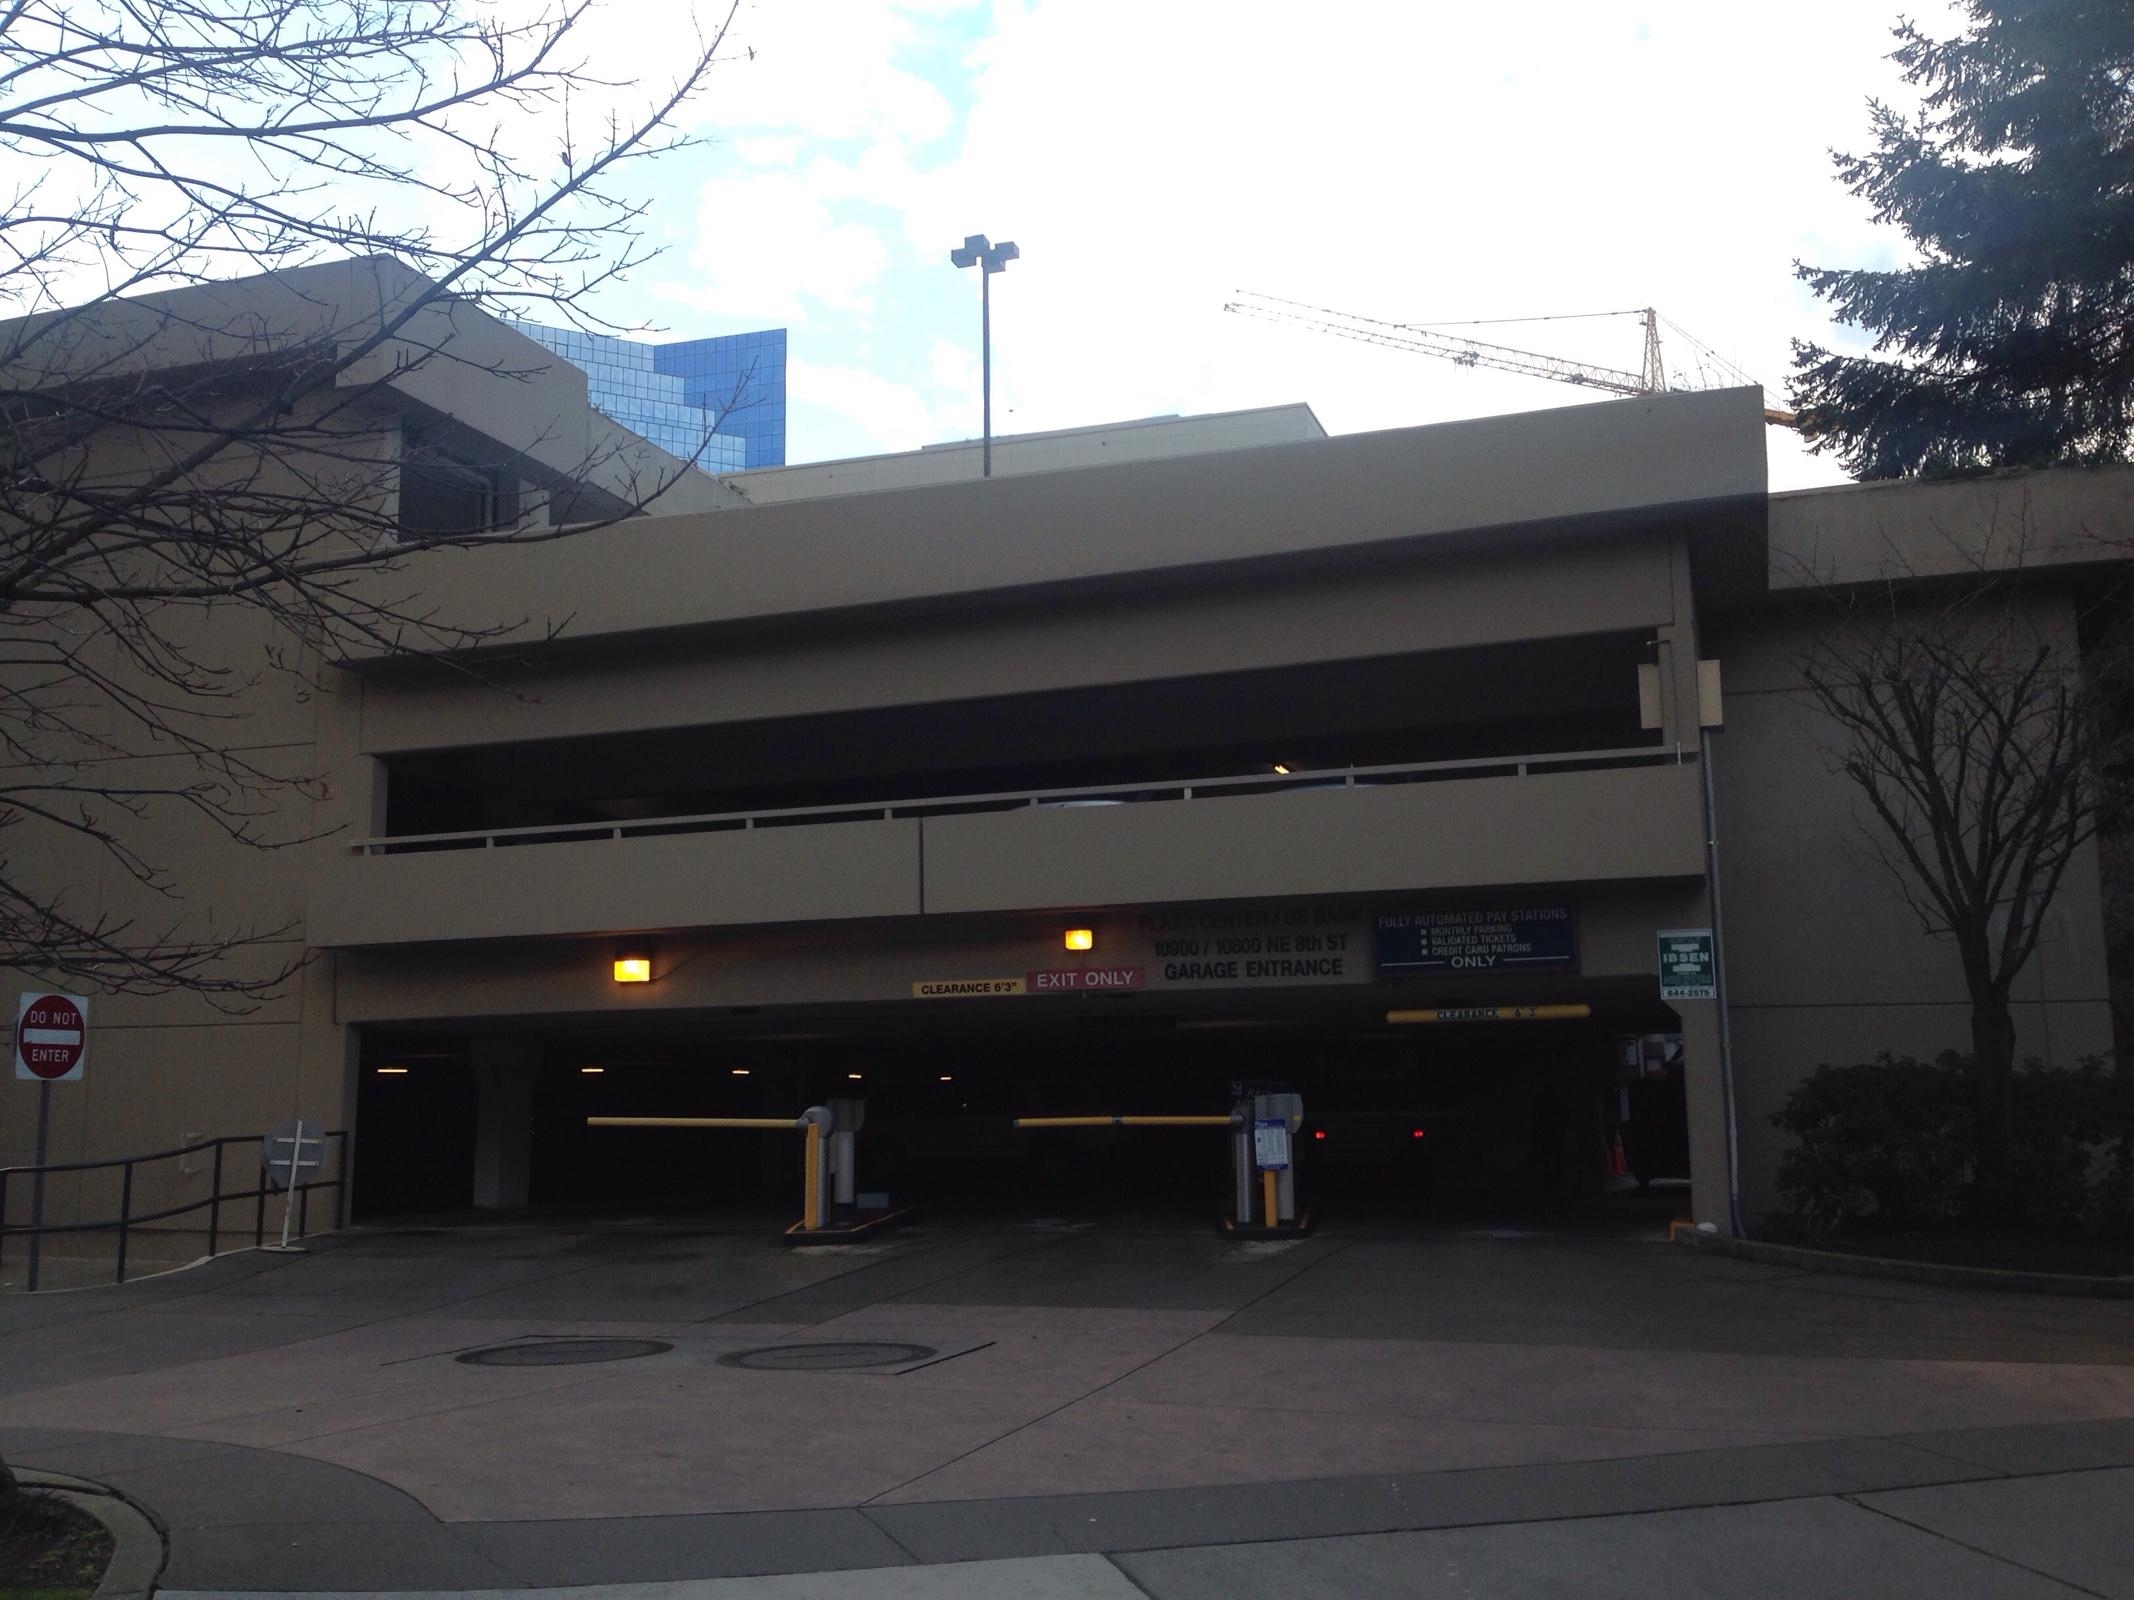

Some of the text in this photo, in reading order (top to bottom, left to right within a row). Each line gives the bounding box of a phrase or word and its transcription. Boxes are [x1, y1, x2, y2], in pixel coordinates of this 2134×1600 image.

[1378, 907, 1568, 928] FULLY AUTOMATED PAY STATIONS
[1430, 924, 1513, 936] MONTHLY PARKING
[1153, 940, 1199, 958] 10900
[1215, 937, 1261, 954] 10800
[1267, 936, 1290, 953] NE
[1295, 934, 1322, 952] 8th
[1326, 934, 1349, 950] ST
[1431, 934, 1517, 946] VALIDATED TICKETS
[1431, 943, 1532, 956] CREDIT CARD PATRONS
[1451, 955, 1496, 968] ONLY
[1663, 952, 1709, 963] IBSEN
[1165, 958, 1343, 980] GARAGE ENTRANCE
[1037, 970, 1135, 988] EXIT ONLY
[921, 983, 991, 995] CLEARANCE
[30, 1010, 77, 1025] DO NOT
[1436, 1009, 1498, 1020] CLEARANCE
[32, 1048, 69, 1062] ENTER
